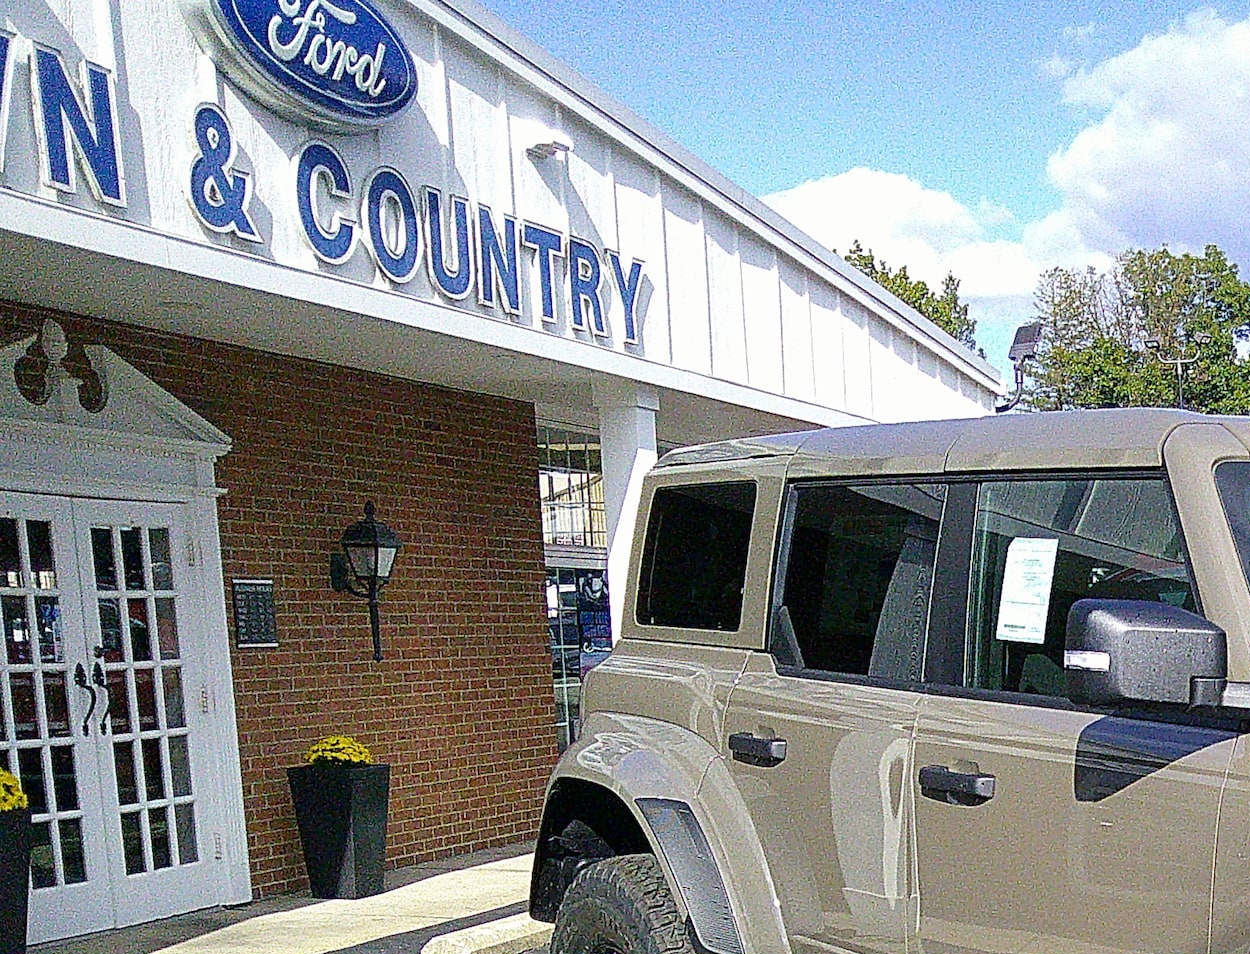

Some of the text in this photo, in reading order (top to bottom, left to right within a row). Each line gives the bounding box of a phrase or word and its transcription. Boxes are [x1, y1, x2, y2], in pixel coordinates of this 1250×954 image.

[268, 0, 386, 97] Ford
[189, 102, 264, 243] &
[298, 137, 645, 346] COUNTRY
